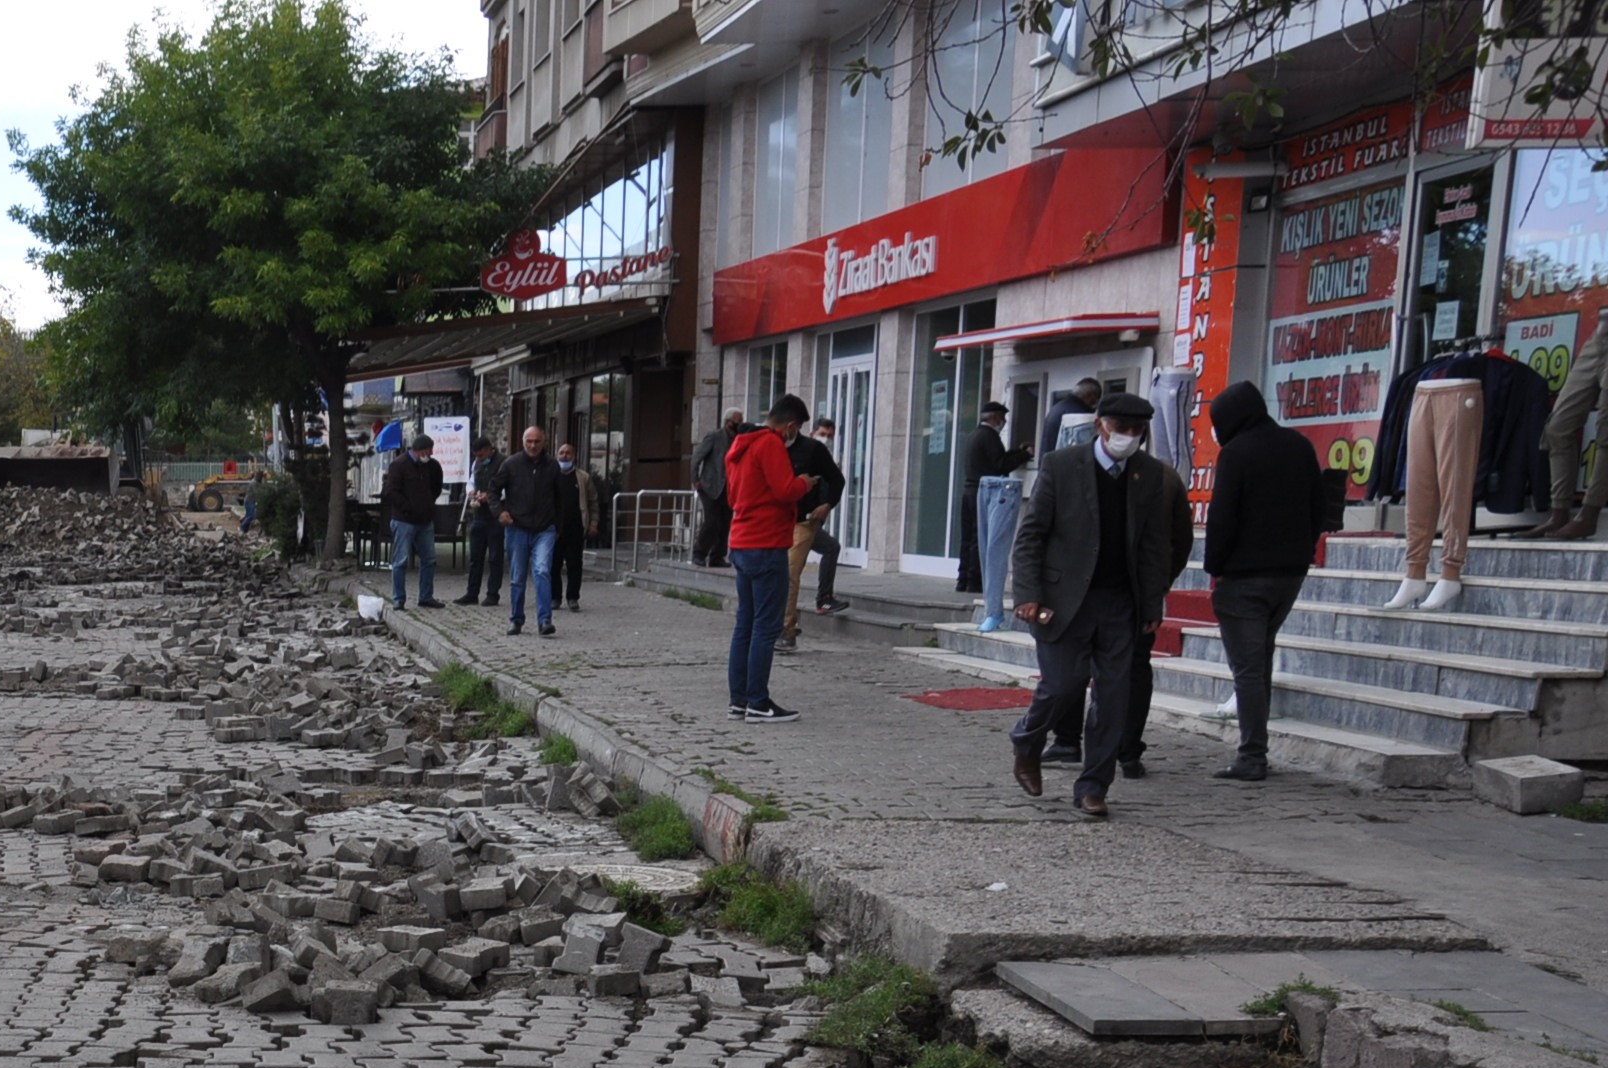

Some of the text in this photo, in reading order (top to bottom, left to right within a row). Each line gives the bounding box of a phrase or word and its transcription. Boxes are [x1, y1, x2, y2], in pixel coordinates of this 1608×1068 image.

[1302, 116, 1388, 157] İSTANBUL
[1282, 153, 1344, 188] TEKSTİL
[1280, 207, 1325, 259] KIŞLIK
[1329, 191, 1360, 241] YENİ
[486, 245, 673, 298] Eylül Pastane
[1307, 254, 1370, 304] ÜRÜNLER
[1520, 320, 1554, 340] BADİ
